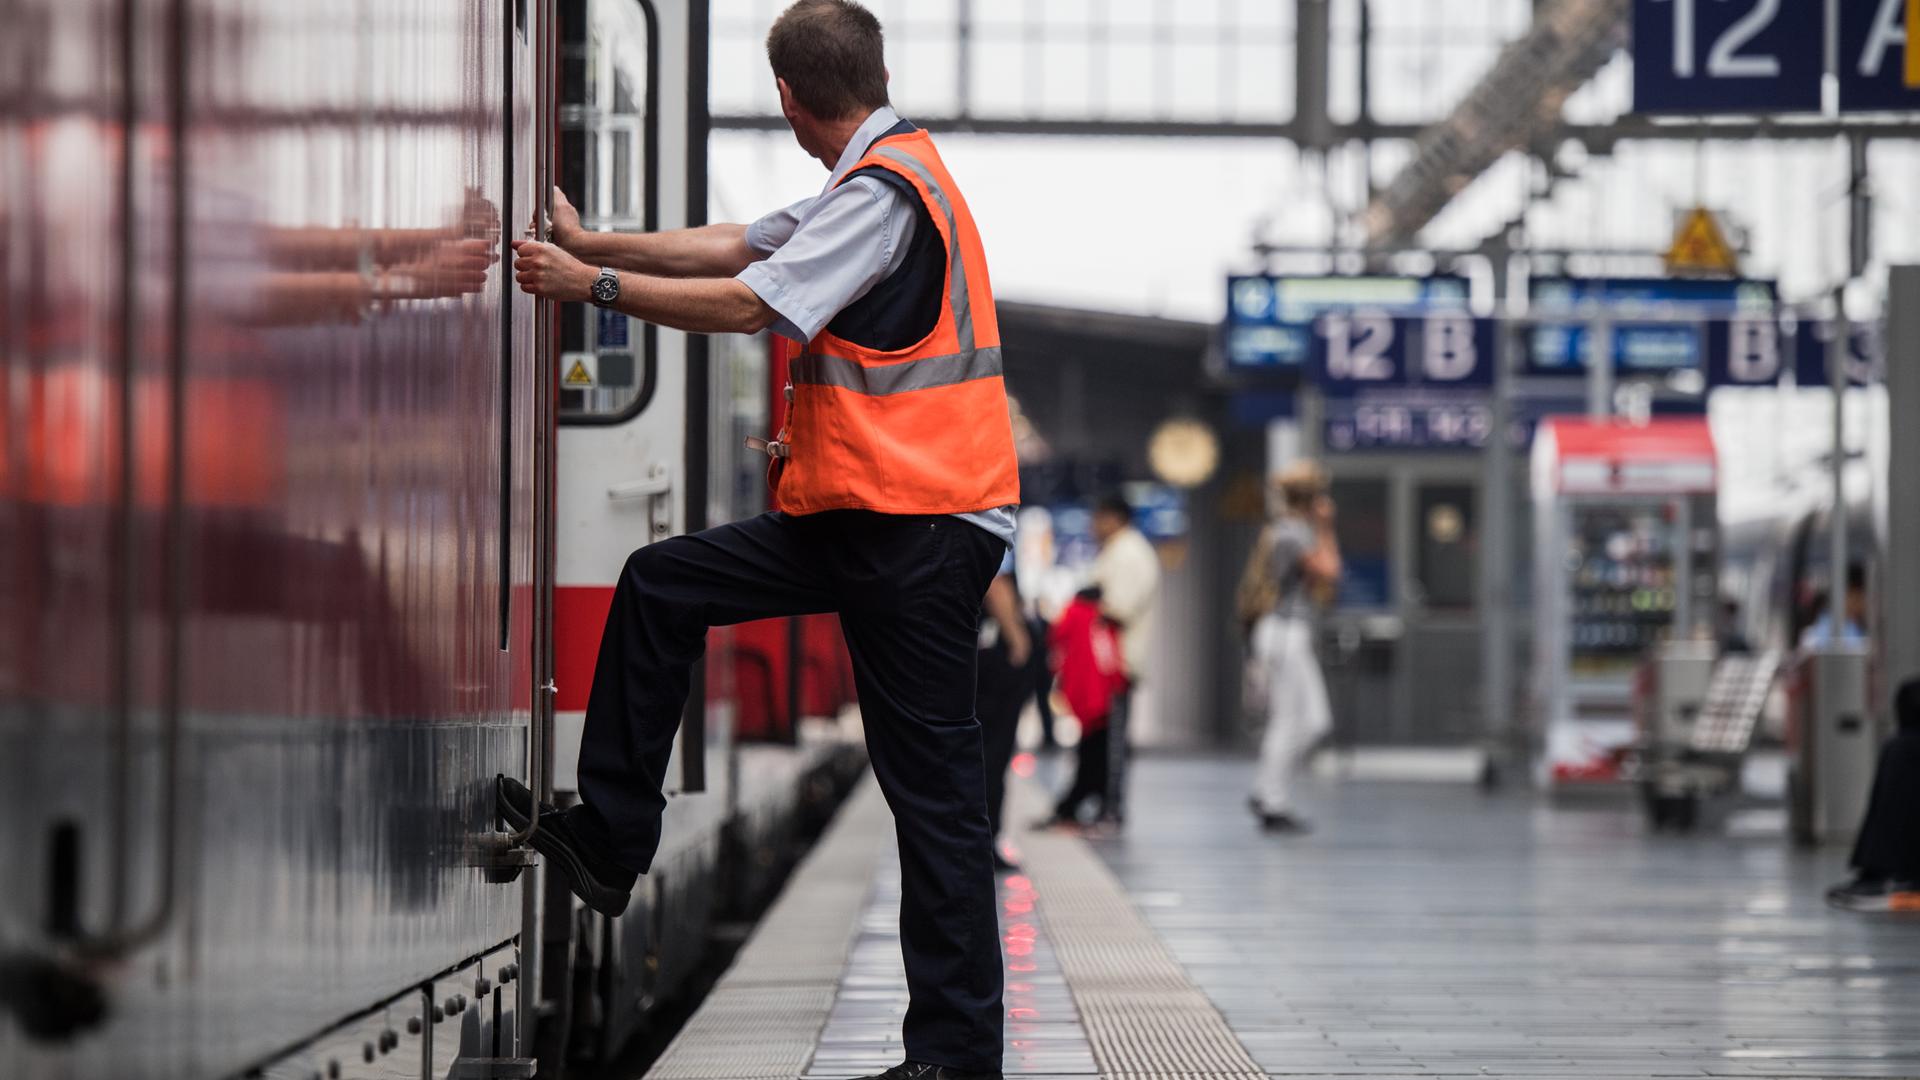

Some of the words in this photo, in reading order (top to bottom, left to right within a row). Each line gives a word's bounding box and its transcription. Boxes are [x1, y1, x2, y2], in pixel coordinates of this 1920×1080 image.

[1651, 0, 1782, 78] 12
[1314, 309, 1395, 379] 12
[1424, 309, 1476, 379] B
[1729, 313, 1779, 381] B
